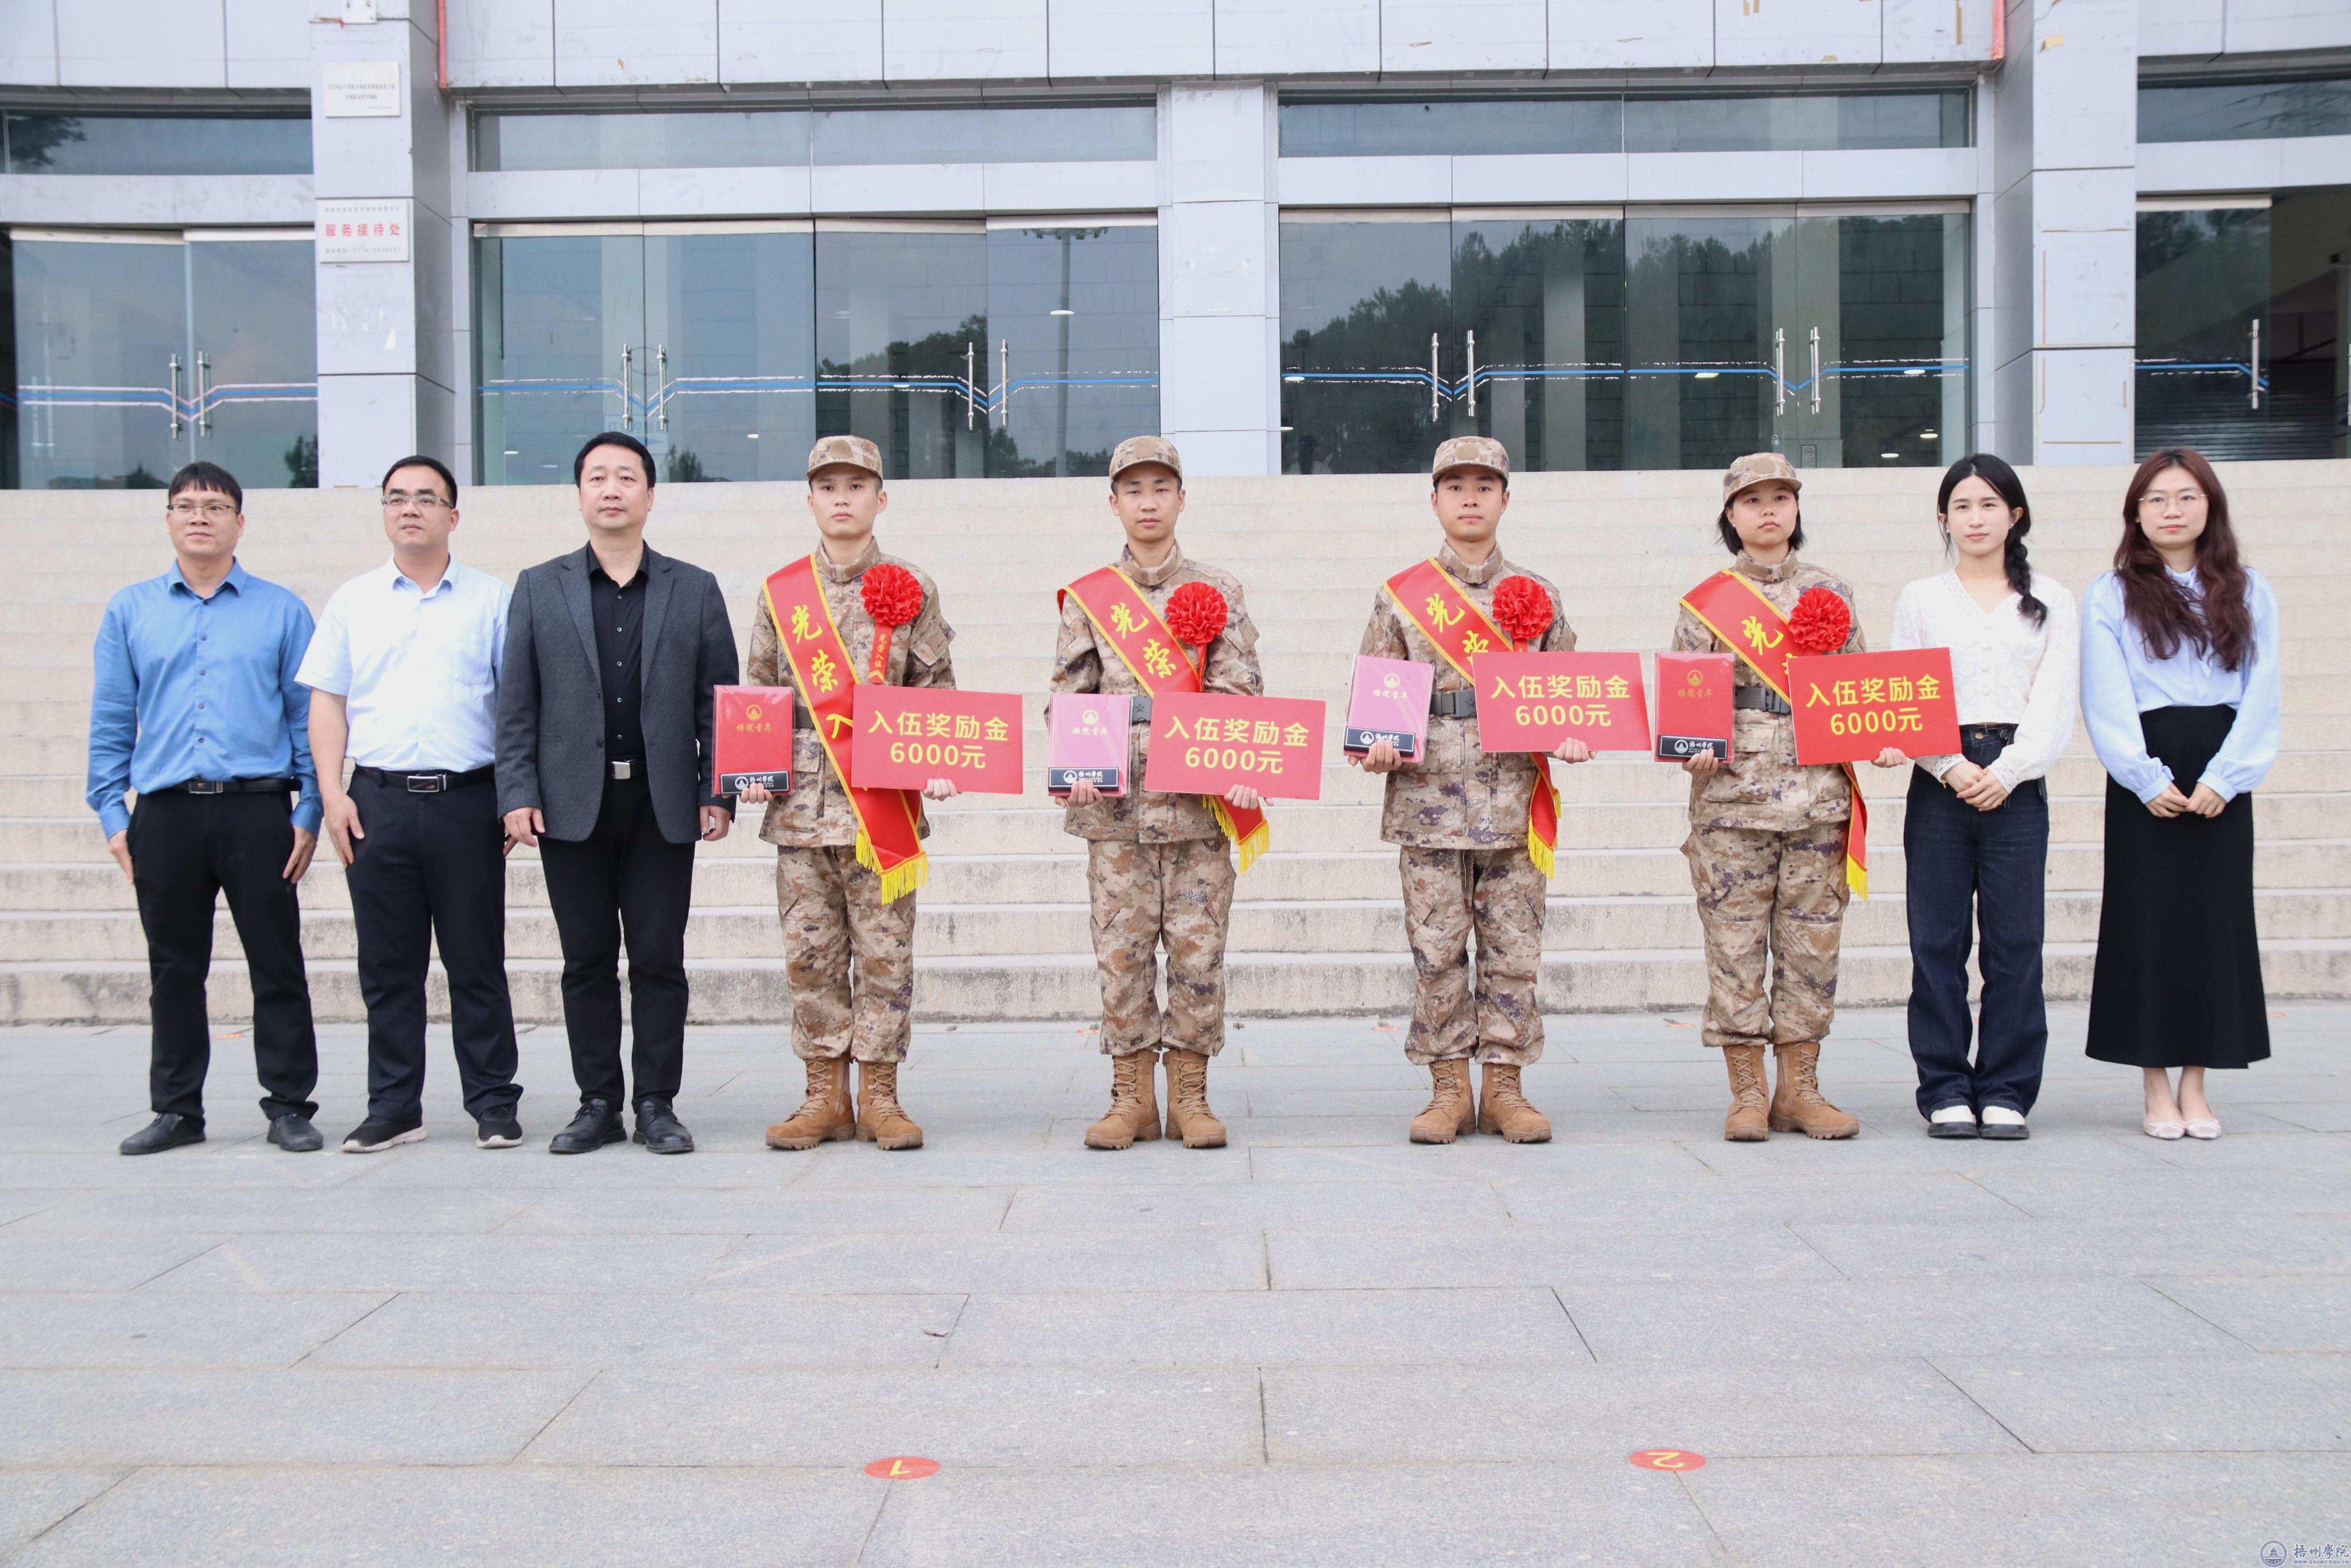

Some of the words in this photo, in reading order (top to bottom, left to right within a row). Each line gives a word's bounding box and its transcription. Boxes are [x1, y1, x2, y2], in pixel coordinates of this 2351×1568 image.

[325, 223, 401, 237] 服务接待处
[874, 633, 887, 668] 光荣入伍
[1110, 602, 1177, 679] 光荣
[1491, 674, 1631, 699] 入伍奖励金
[1806, 674, 1941, 708] 入伍奖励金
[867, 710, 1009, 741] 入伍奖励金
[1515, 704, 1612, 727] 6000元
[1830, 707, 1923, 735] 6000元
[1164, 716, 1309, 747] 入伍奖励金
[890, 742, 986, 769] 6000元
[1185, 747, 1283, 774] 6000元
[1647, 1452, 1685, 1468] 2
